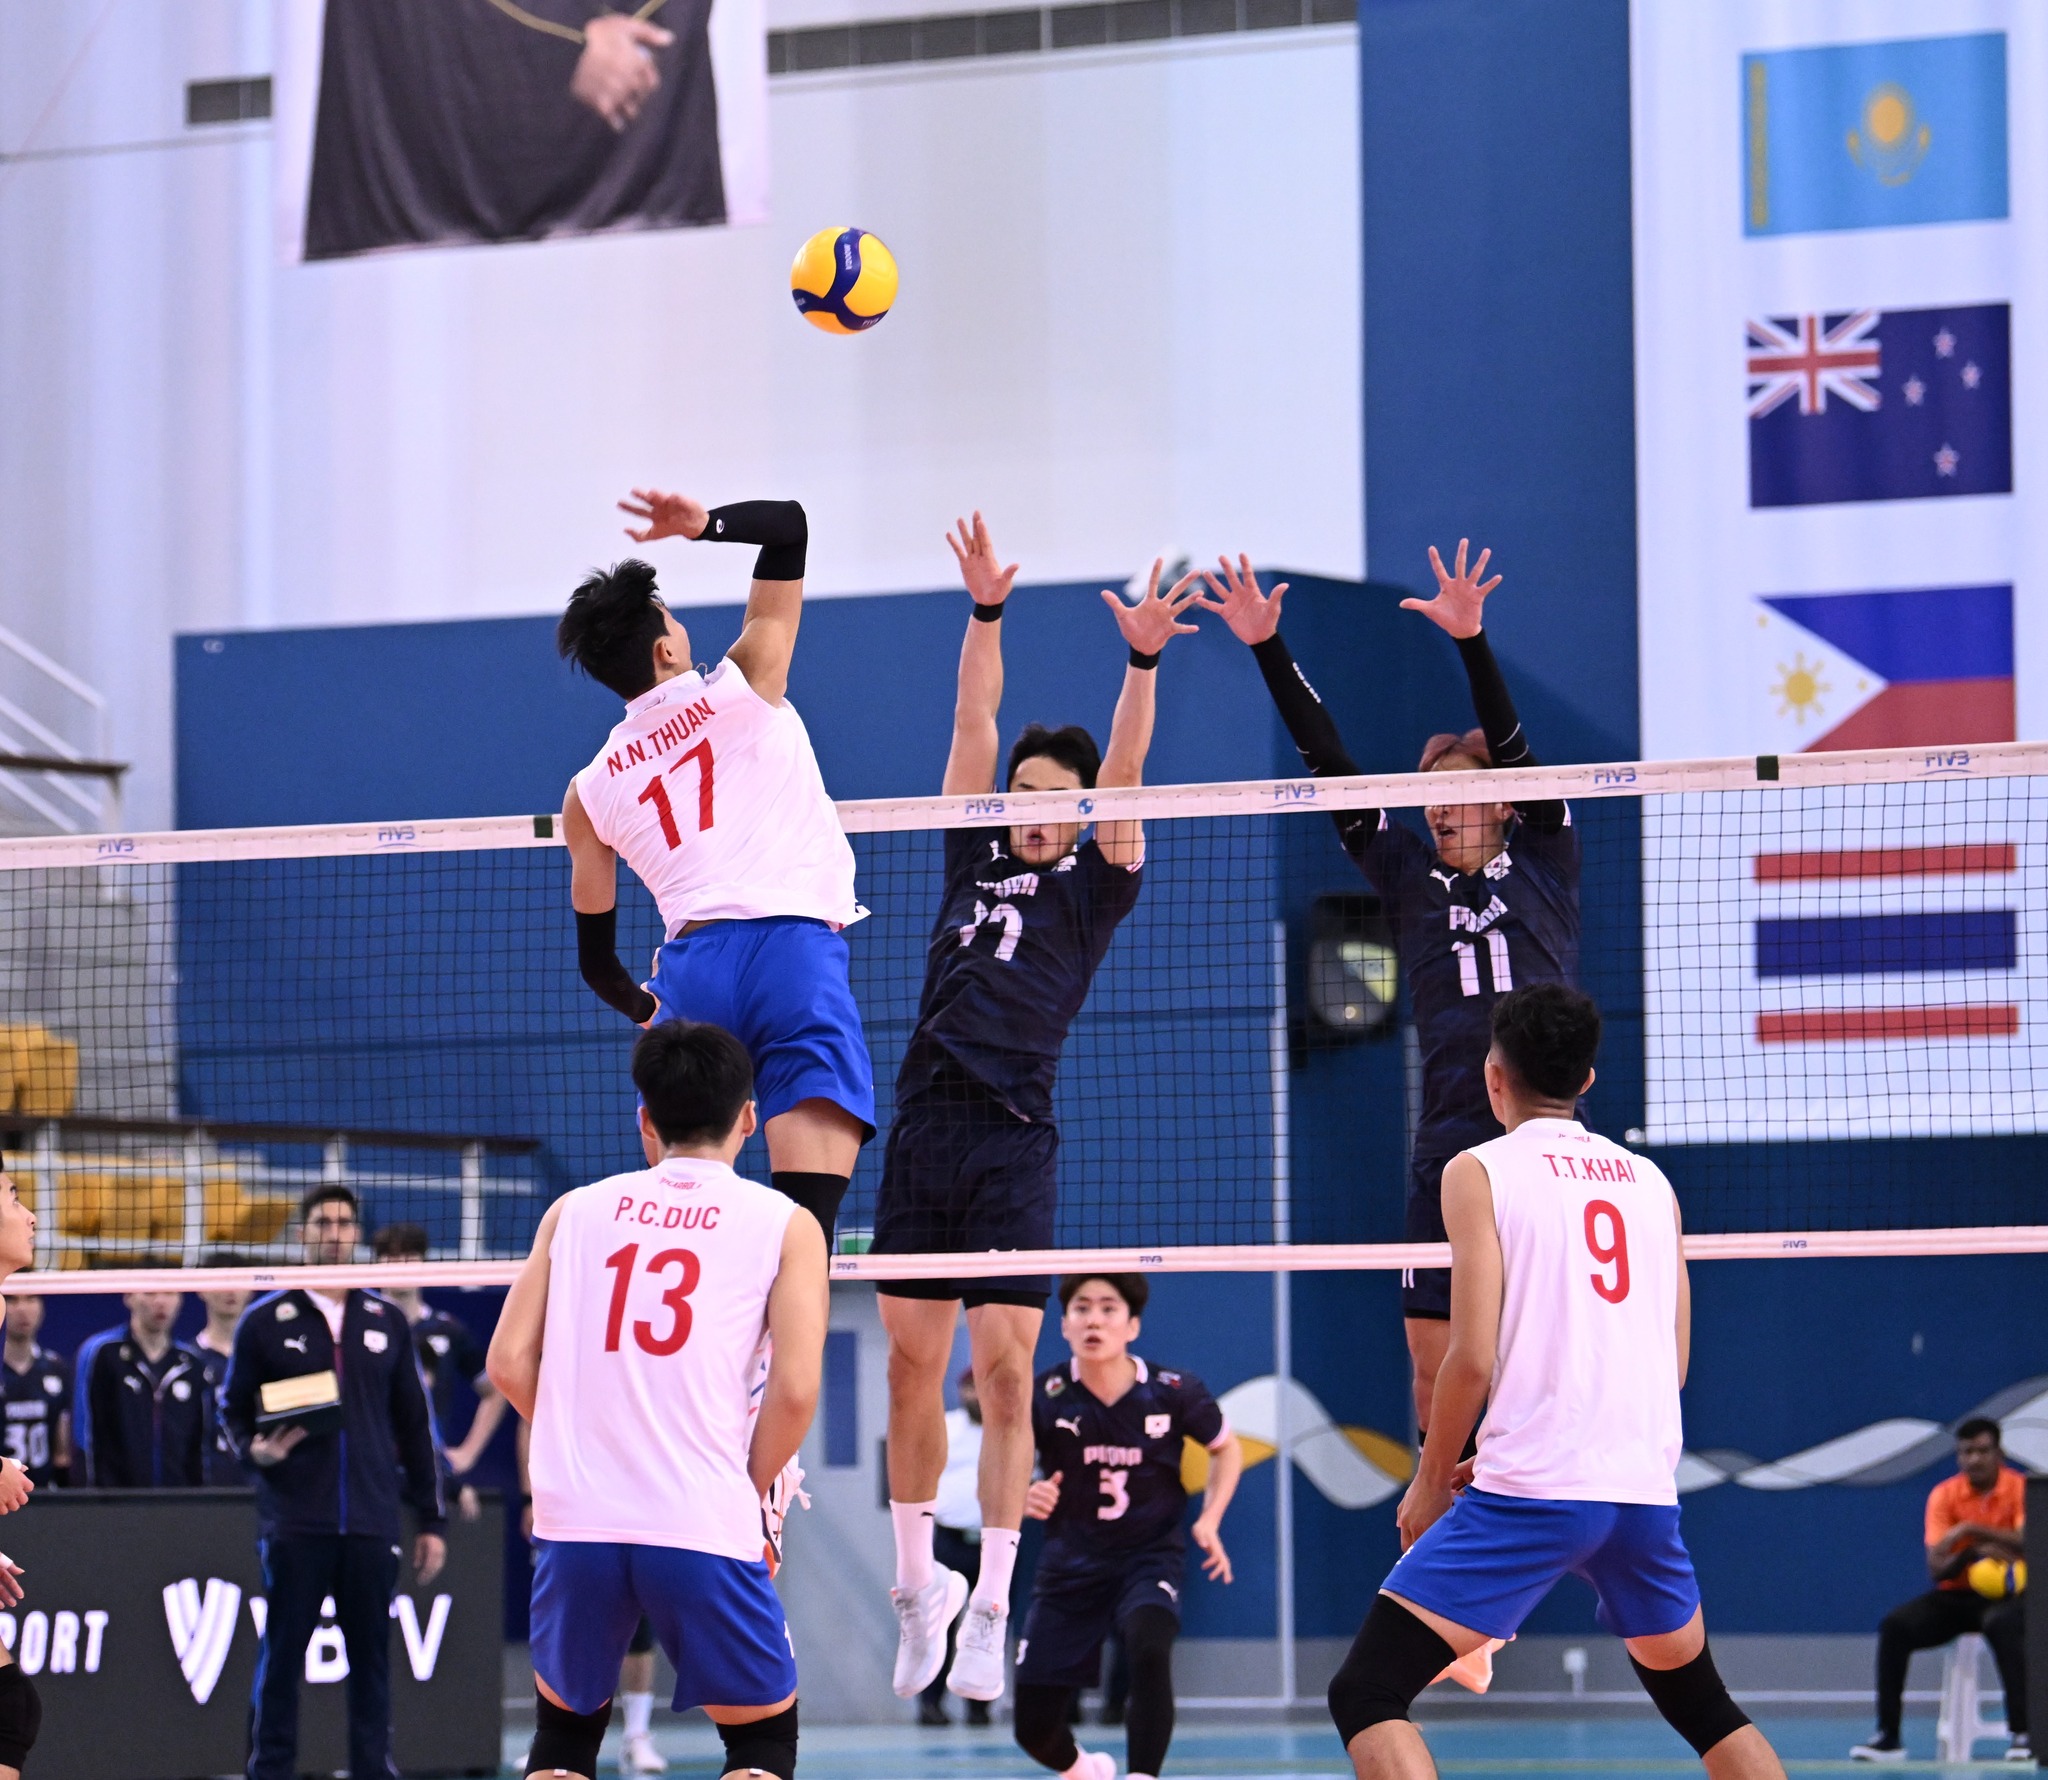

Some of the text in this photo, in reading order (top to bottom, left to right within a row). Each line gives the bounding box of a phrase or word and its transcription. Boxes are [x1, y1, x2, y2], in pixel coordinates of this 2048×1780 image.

[607, 696, 716, 777] N.N.THUAN
[1925, 750, 1970, 767] FIVB
[1594, 767, 1637, 784] FIVB
[637, 737, 715, 851] 17
[964, 798, 1006, 815] FIVB
[1274, 783, 1317, 800] FIVB
[98, 837, 135, 853] FIVB
[378, 825, 416, 841] FIVB
[1451, 928, 1514, 997] 11
[1542, 1154, 1637, 1184] T.T.KHAI
[614, 1196, 721, 1230] P.C.DUC
[1583, 1199, 1630, 1304] 9
[1782, 1240, 1808, 1249] FIVB
[604, 1242, 701, 1356] 13
[1097, 1468, 1130, 1520] 3
